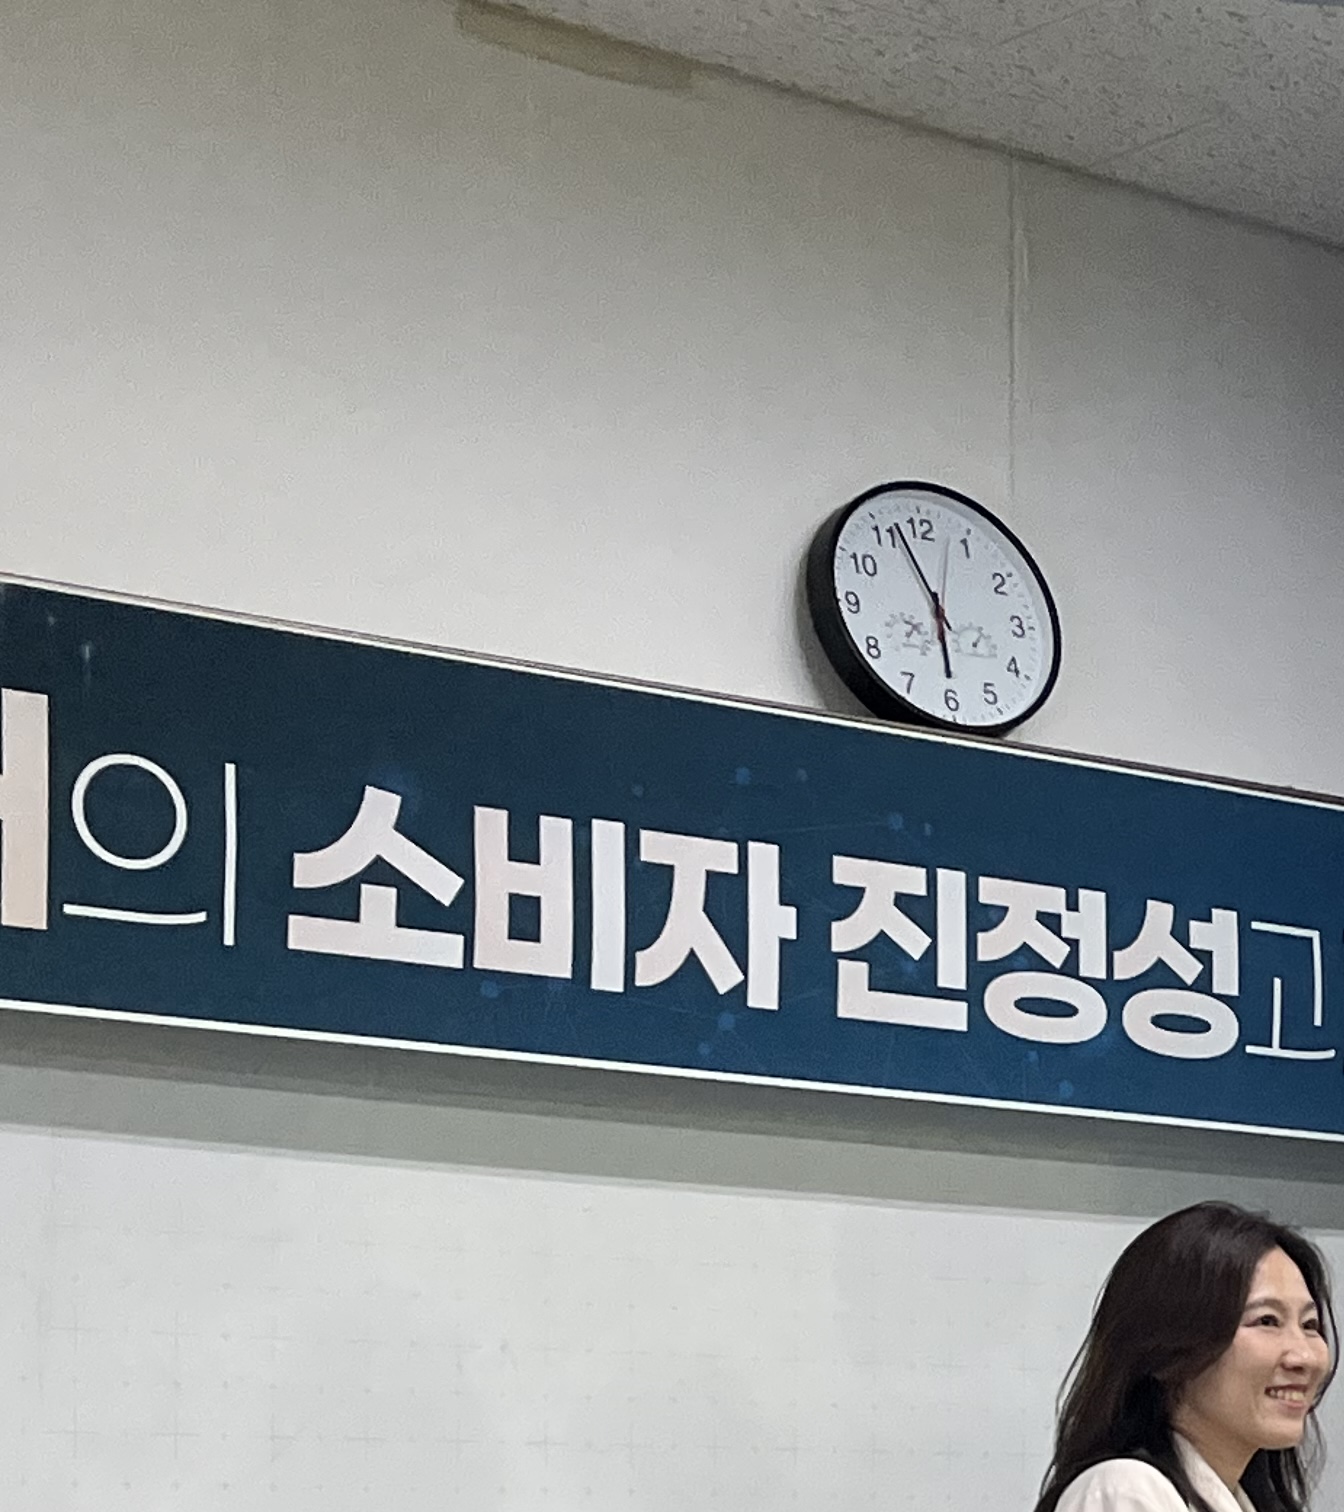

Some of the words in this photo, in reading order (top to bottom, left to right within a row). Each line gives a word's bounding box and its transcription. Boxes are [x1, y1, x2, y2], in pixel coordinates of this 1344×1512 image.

[872, 524, 897, 548] 11
[906, 517, 935, 542] 12
[960, 537, 970, 559] 1
[850, 552, 877, 577] 10
[992, 572, 1008, 596] 2
[845, 591, 861, 614] 9
[1010, 615, 1025, 638] 3
[865, 636, 881, 659] 8
[1006, 656, 1020, 678] 4
[900, 671, 915, 694] 7
[983, 682, 998, 705] 5
[944, 689, 959, 712] 6
[287, 785, 797, 1010] 소비자
